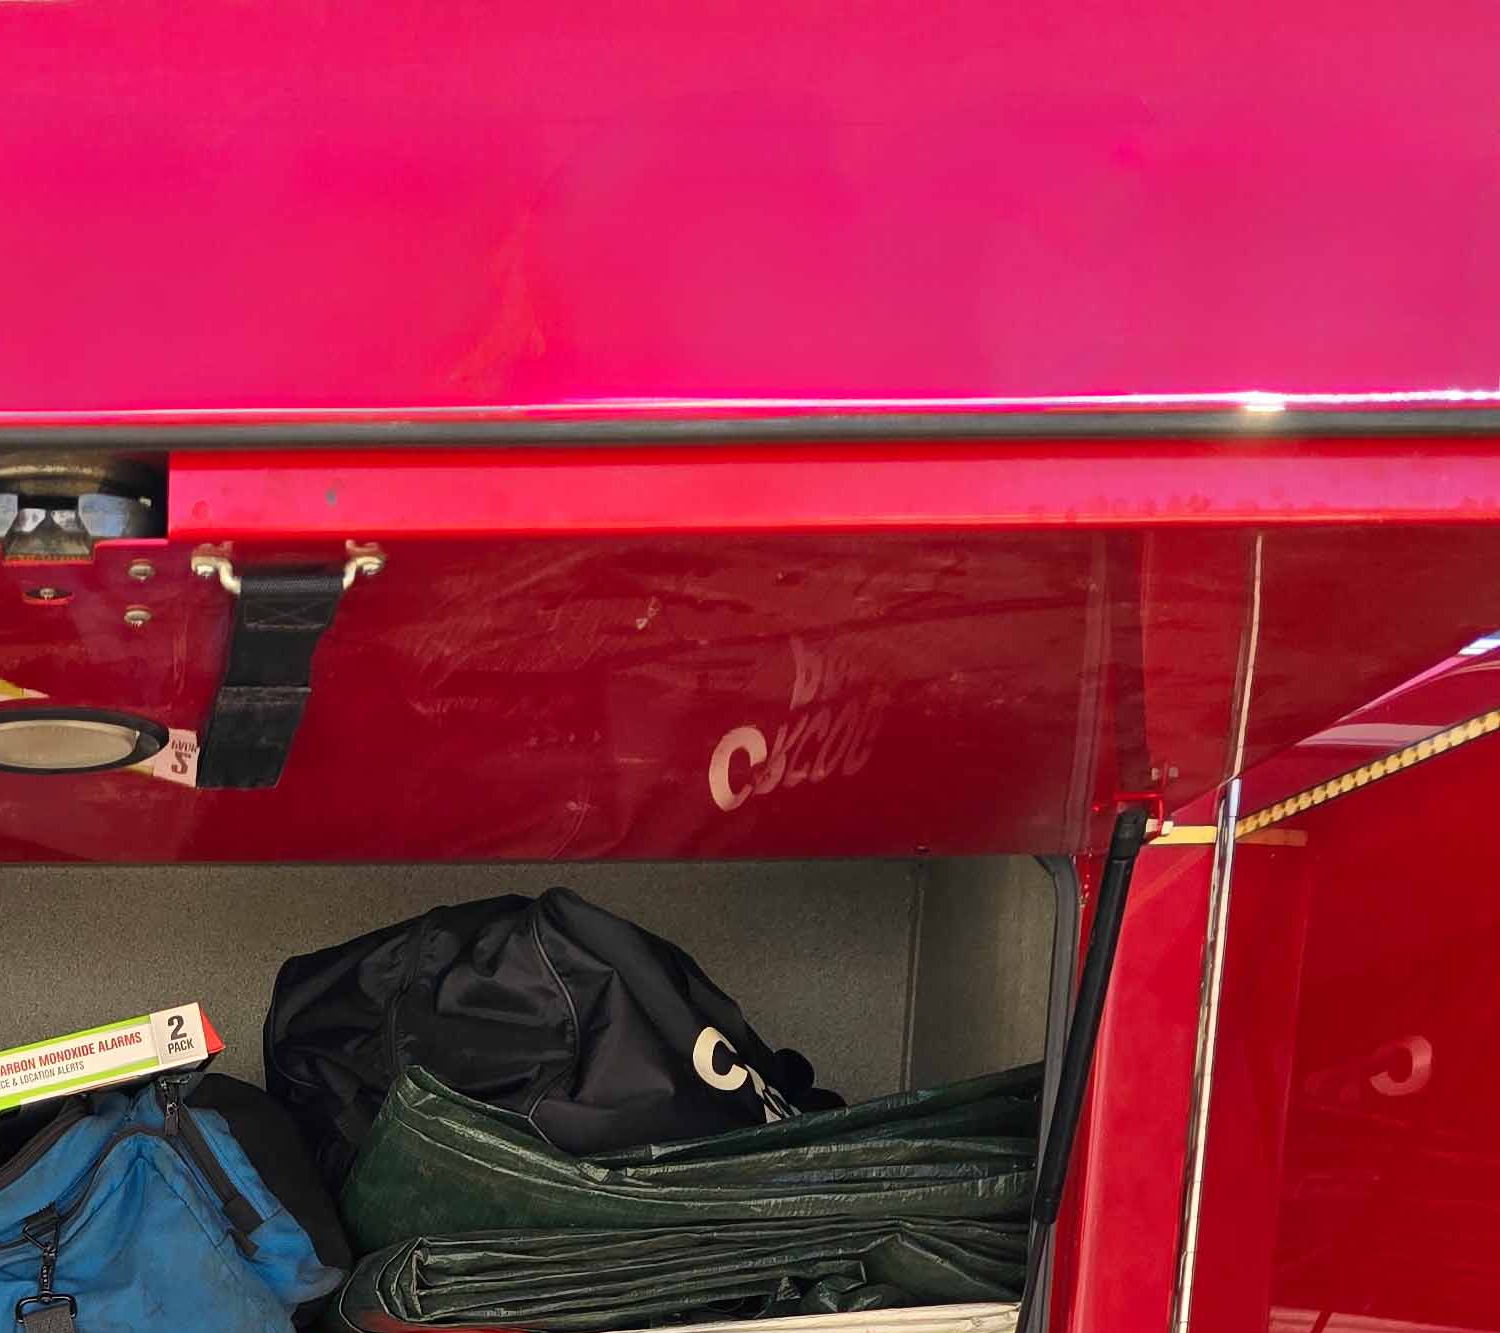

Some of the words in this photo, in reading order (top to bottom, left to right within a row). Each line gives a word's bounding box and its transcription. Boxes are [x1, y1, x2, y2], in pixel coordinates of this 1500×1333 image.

[167, 1015, 187, 1041] 2
[38, 1042, 95, 1068] MONOXIDE
[98, 1032, 142, 1053] ALARMS
[167, 1038, 195, 1054] PACK
[12, 1077, 18, 1086] &
[20, 1067, 55, 1084] LOCATION
[57, 1060, 85, 1076] ALERTS
